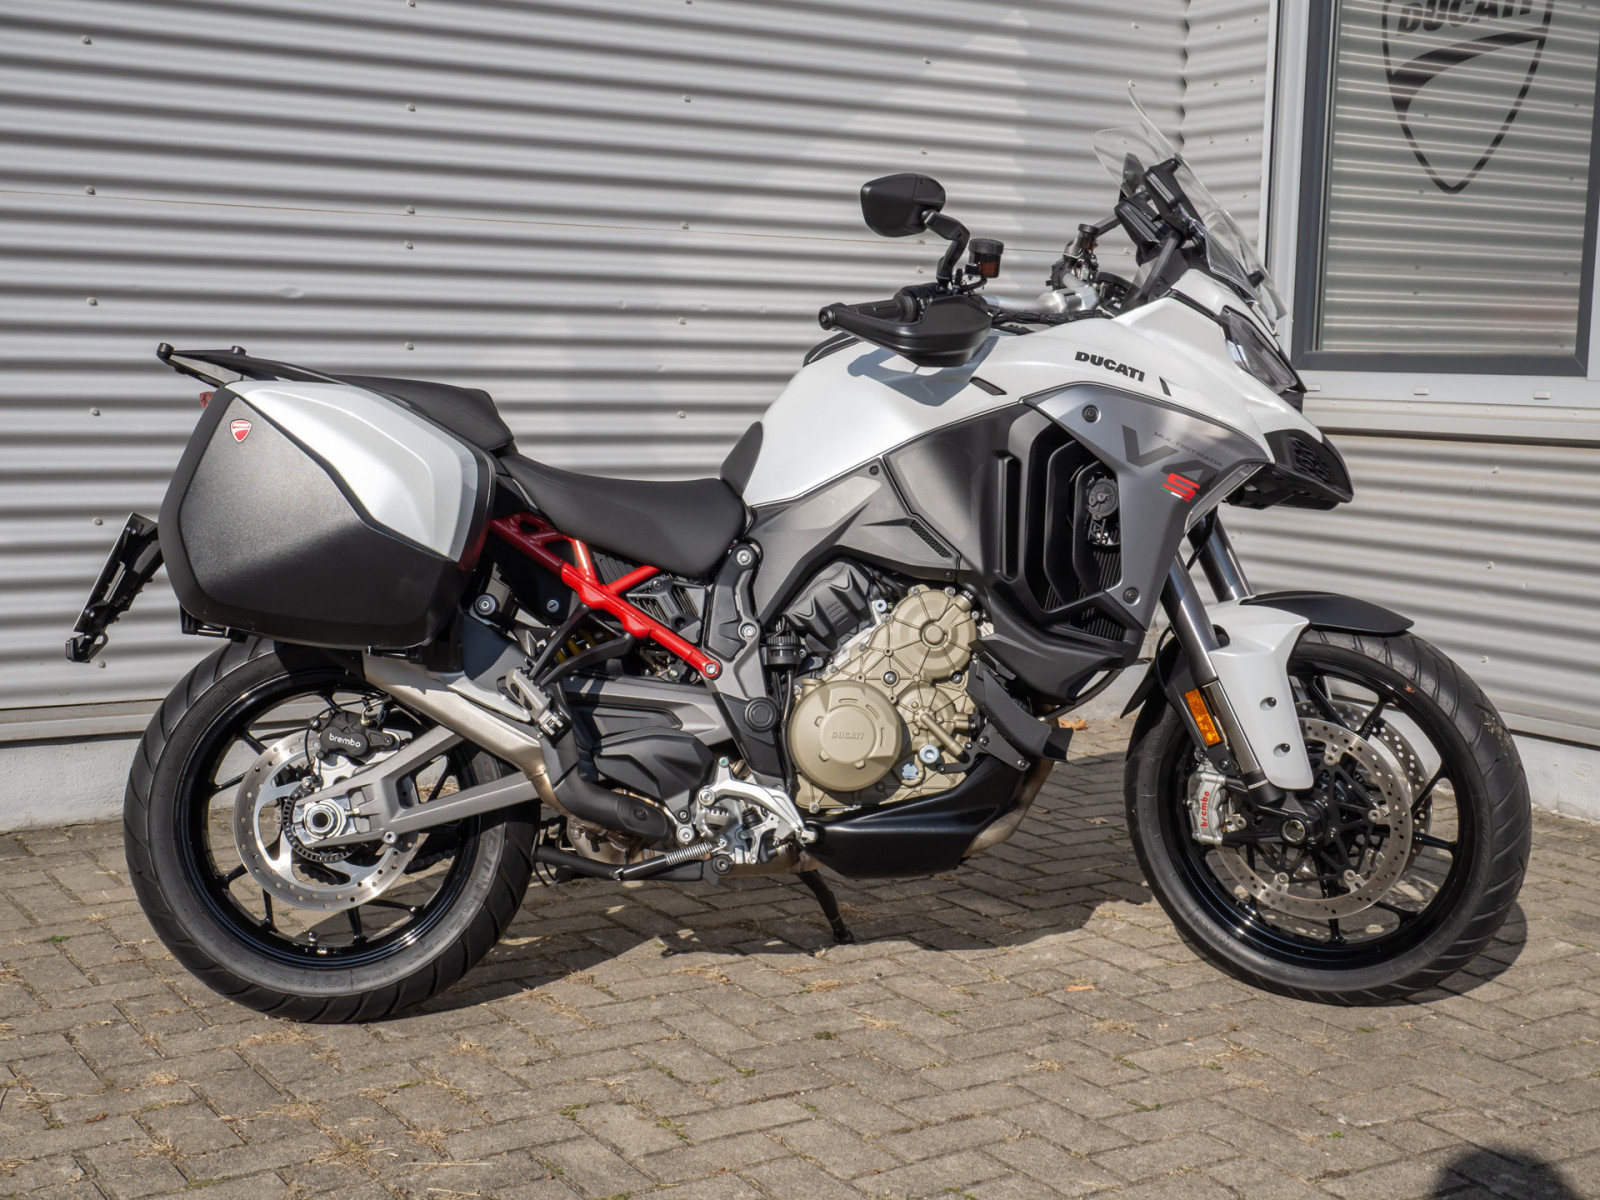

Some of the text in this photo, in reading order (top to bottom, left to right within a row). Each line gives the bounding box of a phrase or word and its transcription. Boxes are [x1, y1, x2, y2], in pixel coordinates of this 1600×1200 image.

[1074, 350, 1146, 383] DUCATI
[328, 732, 362, 748] brembo
[831, 731, 865, 741] DUCATI
[1200, 790, 1210, 828] brembo
